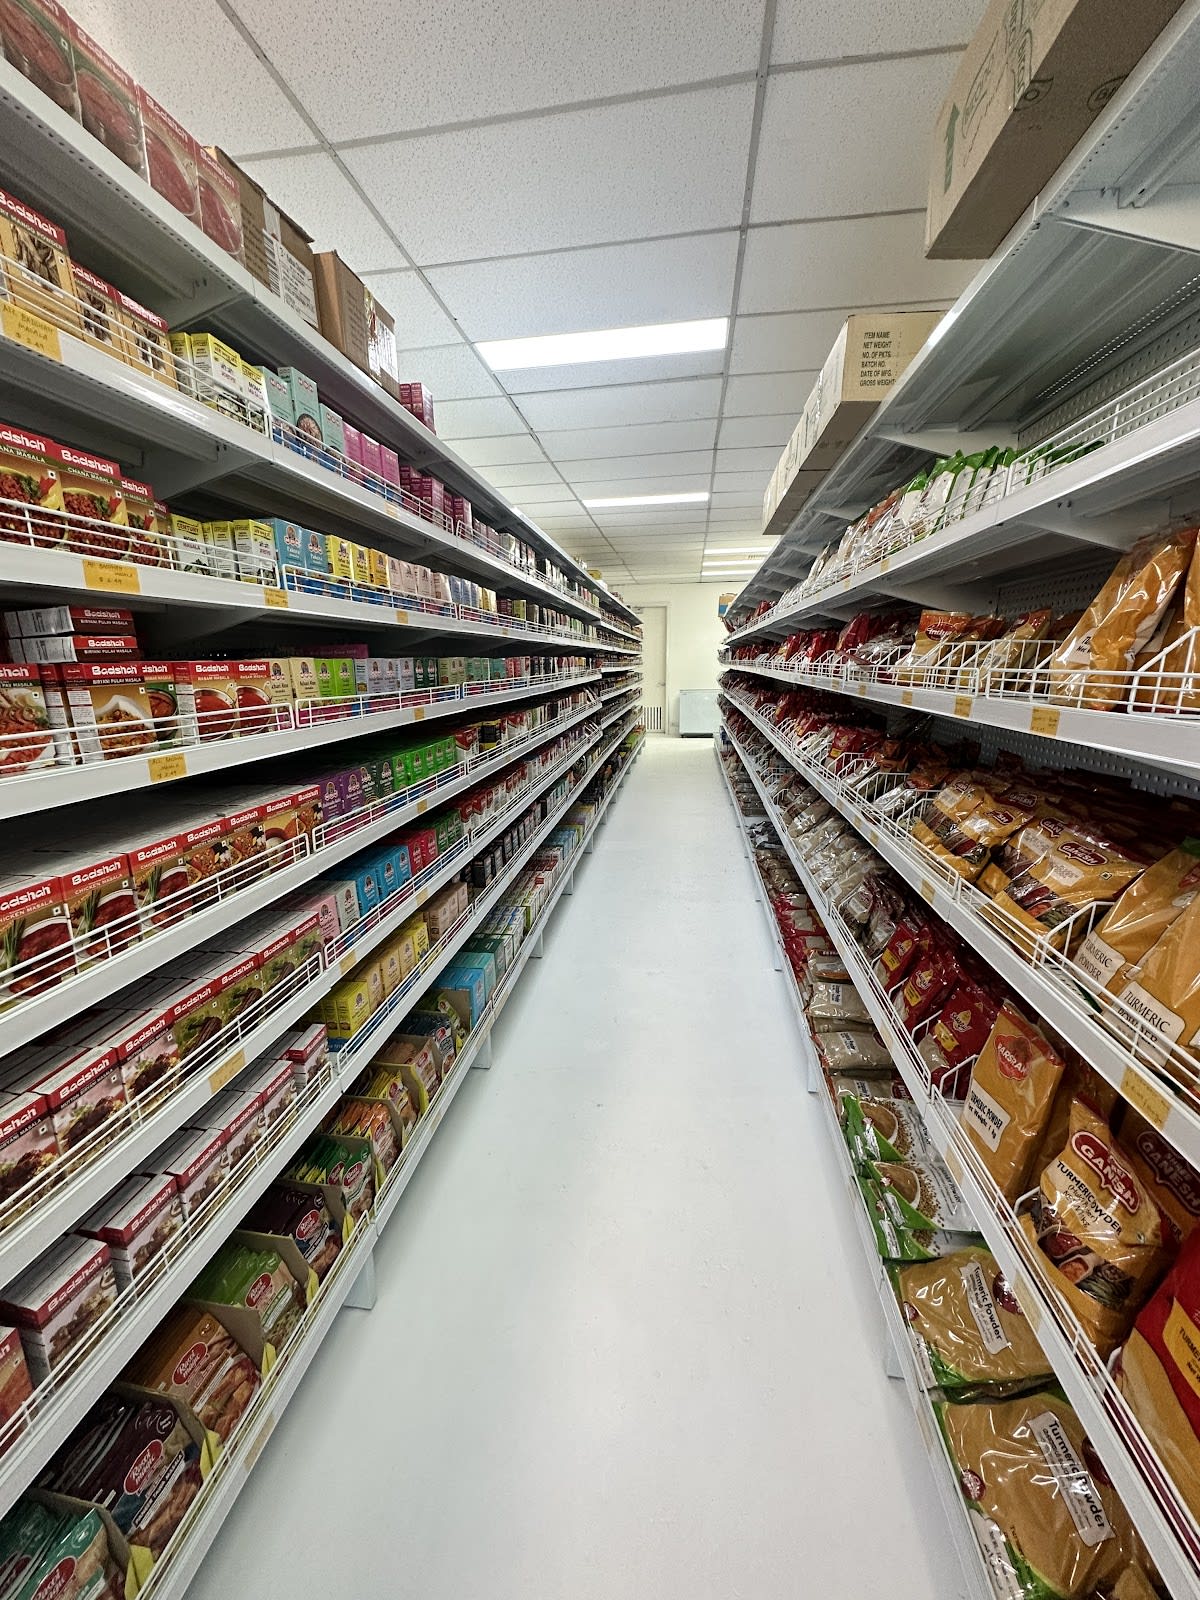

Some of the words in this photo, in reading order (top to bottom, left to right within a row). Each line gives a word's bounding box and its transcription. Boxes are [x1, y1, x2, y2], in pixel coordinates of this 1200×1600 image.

[863, 341, 873, 349] NET
[876, 331, 890, 339] NAME
[859, 379, 876, 387] GROSS
[860, 370, 873, 378] DATE
[16, 450, 46, 464] MASALA
[61, 449, 114, 475] Badshah
[67, 467, 90, 477] CHANA
[90, 473, 114, 485] MASALA
[84, 609, 120, 619] Badshah
[87, 639, 125, 647] Badshah
[91, 665, 137, 676] Badshah
[195, 665, 229, 673] Badshah
[230, 811, 258, 826] Badshah
[187, 824, 221, 842] Badshah
[137, 840, 177, 861] Badshah
[1062, 845, 1098, 865] GANESH
[72, 860, 121, 886] Badshah
[75, 882, 101, 896] CHICKEN
[101, 873, 123, 885] MASALA
[0, 885, 51, 911] adshah
[26, 899, 53, 913] MASALA
[263, 937, 289, 958] Badshah
[1084, 938, 1113, 968] TURMERIC
[221, 961, 254, 985] Badshah
[1078, 953, 1102, 981] POWDER
[174, 987, 211, 1016] Badshah
[1123, 990, 1171, 1034] TURMERIC
[125, 1019, 166, 1052] Badshah
[60, 1058, 110, 1099] Badshah
[229, 1102, 259, 1133] Badshah
[986, 1107, 1003, 1131] POWDER
[188, 1140, 221, 1177] Badshah
[1057, 1160, 1096, 1204] TURMERIC
[1080, 1144, 1135, 1206] GANESH
[131, 1187, 171, 1231] Badshah
[48, 1256, 102, 1312] Badshah
[974, 1266, 988, 1303] Turmeric
[985, 1303, 1003, 1340] Powder
[1048, 1420, 1081, 1474] Turmeric
[1075, 1475, 1104, 1527] Powder
